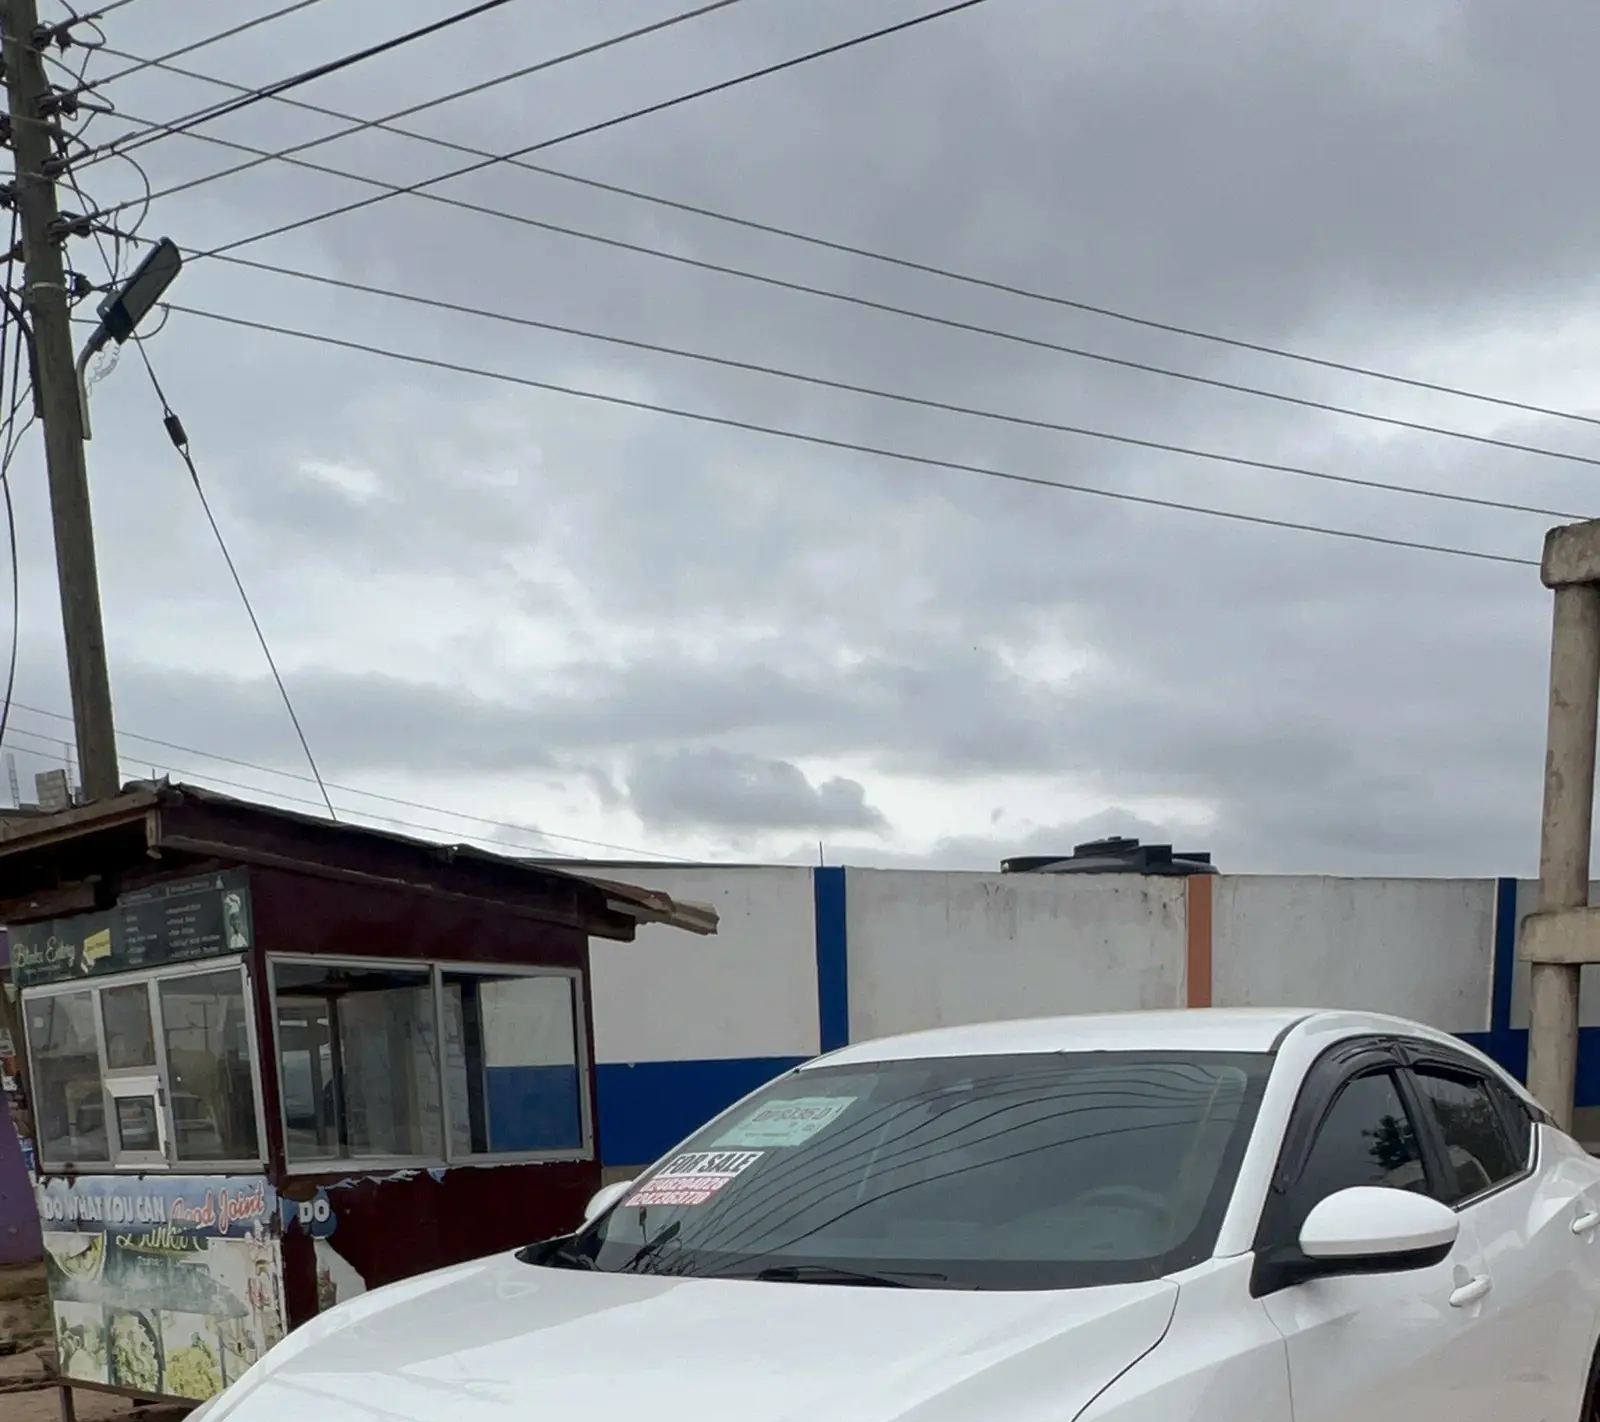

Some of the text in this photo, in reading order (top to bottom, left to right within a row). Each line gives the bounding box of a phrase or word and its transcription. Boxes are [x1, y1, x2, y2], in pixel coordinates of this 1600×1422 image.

[659, 1153, 757, 1175] FOR SALE
[43, 1198, 64, 1221] DO
[68, 1196, 104, 1222] WHAT
[102, 1196, 134, 1223] YOU
[136, 1196, 167, 1223] CAN
[218, 1180, 265, 1236] Joint
[298, 1199, 331, 1223] DO
